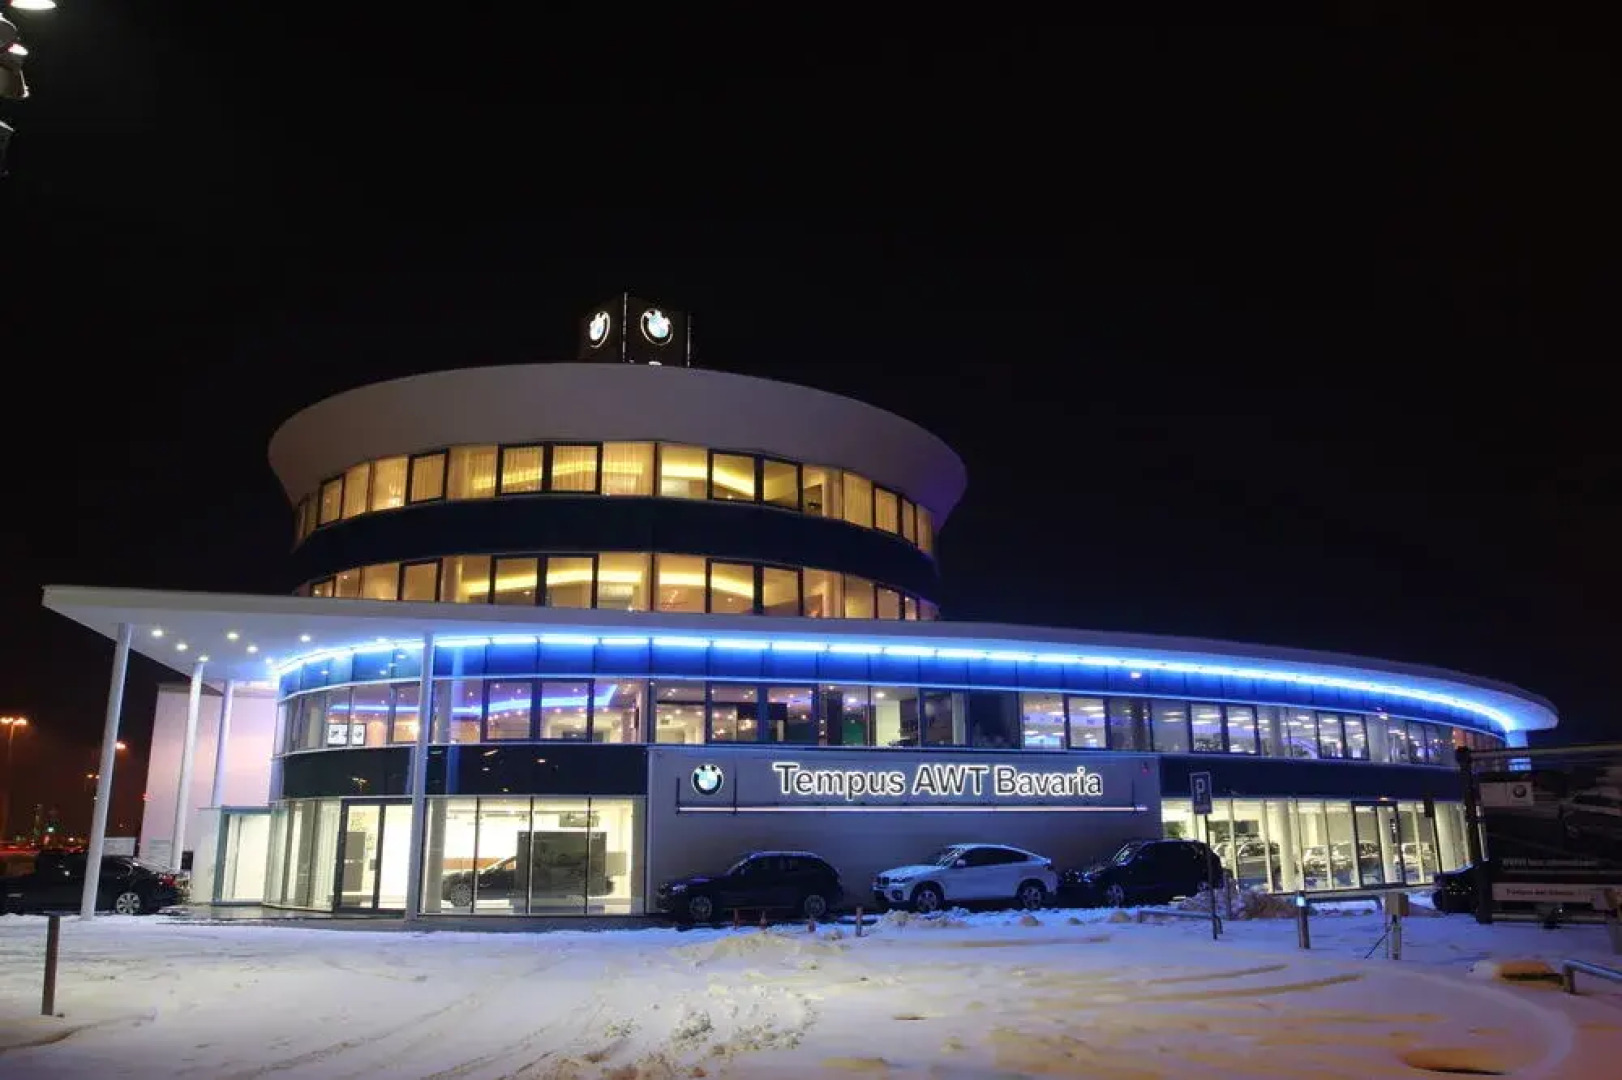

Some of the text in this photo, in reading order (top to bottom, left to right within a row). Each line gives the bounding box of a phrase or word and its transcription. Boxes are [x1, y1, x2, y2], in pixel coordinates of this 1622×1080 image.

[772, 762, 1103, 801] Tempus AWT Bavaria
[1196, 778, 1205, 801] P
